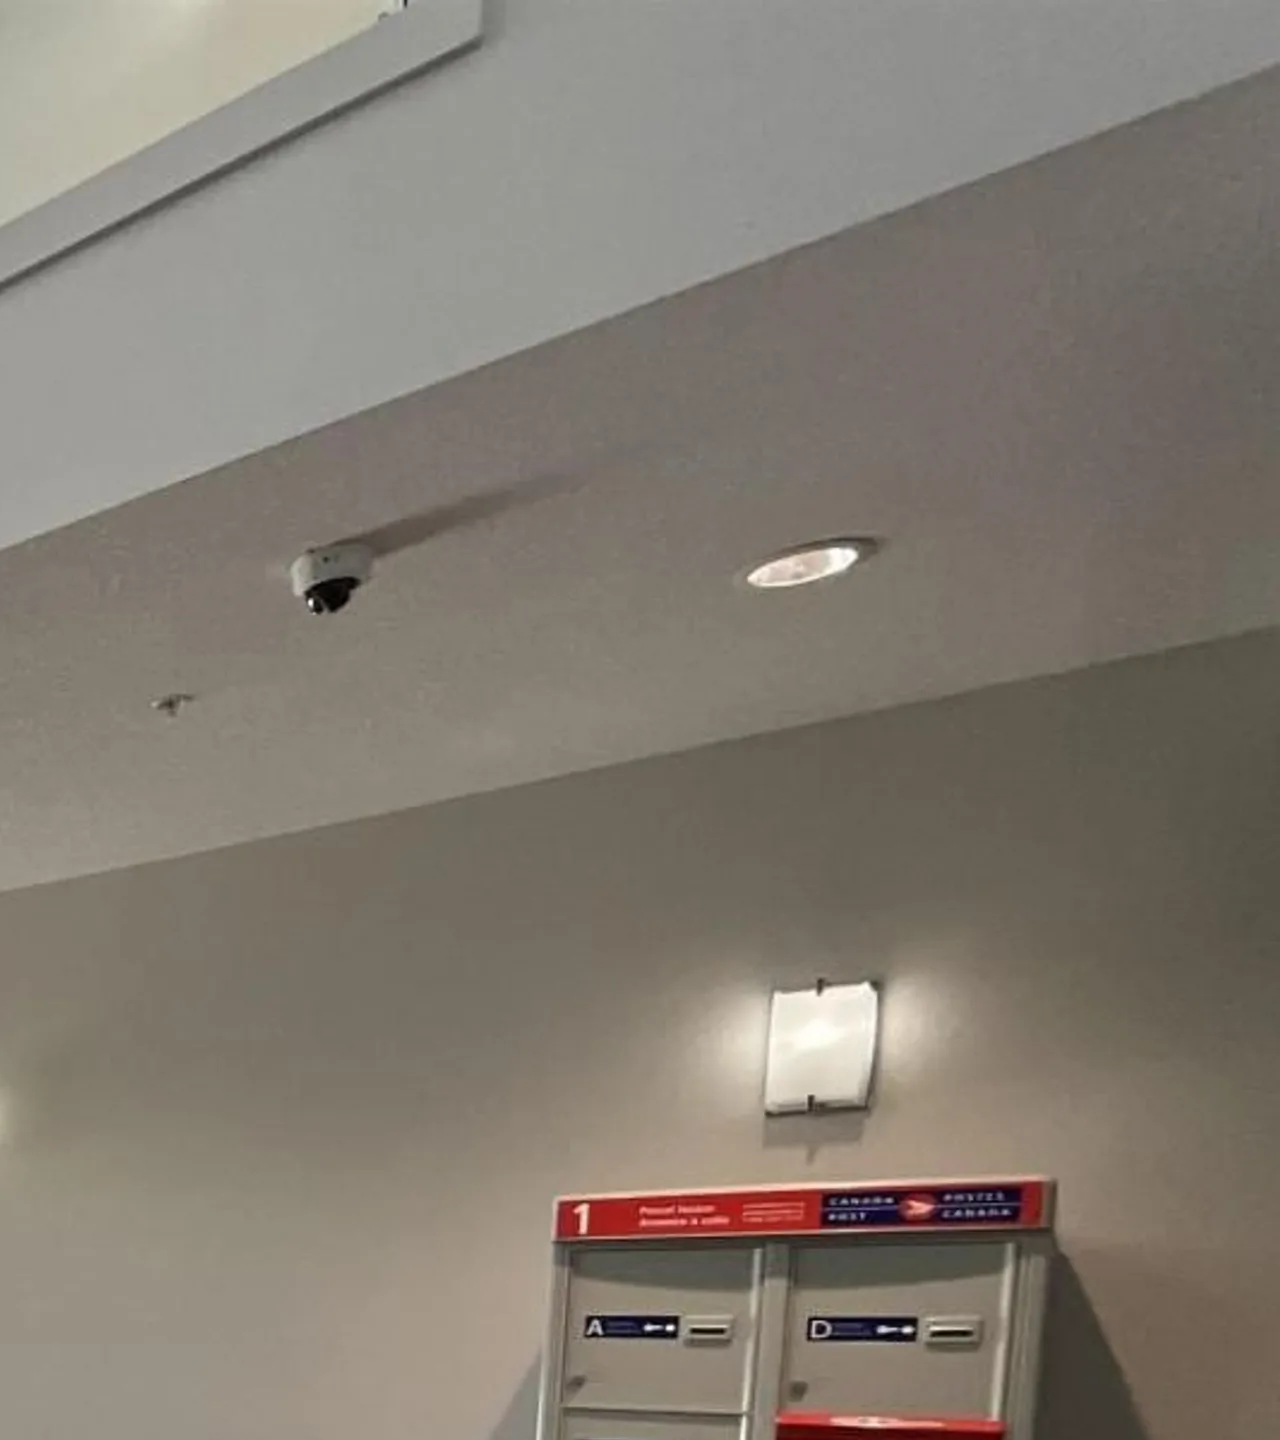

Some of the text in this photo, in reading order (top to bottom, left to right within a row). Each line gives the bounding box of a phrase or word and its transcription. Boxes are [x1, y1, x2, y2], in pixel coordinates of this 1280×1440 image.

[572, 1202, 590, 1235] 1
[586, 1318, 604, 1336] A
[810, 1319, 833, 1339] D
